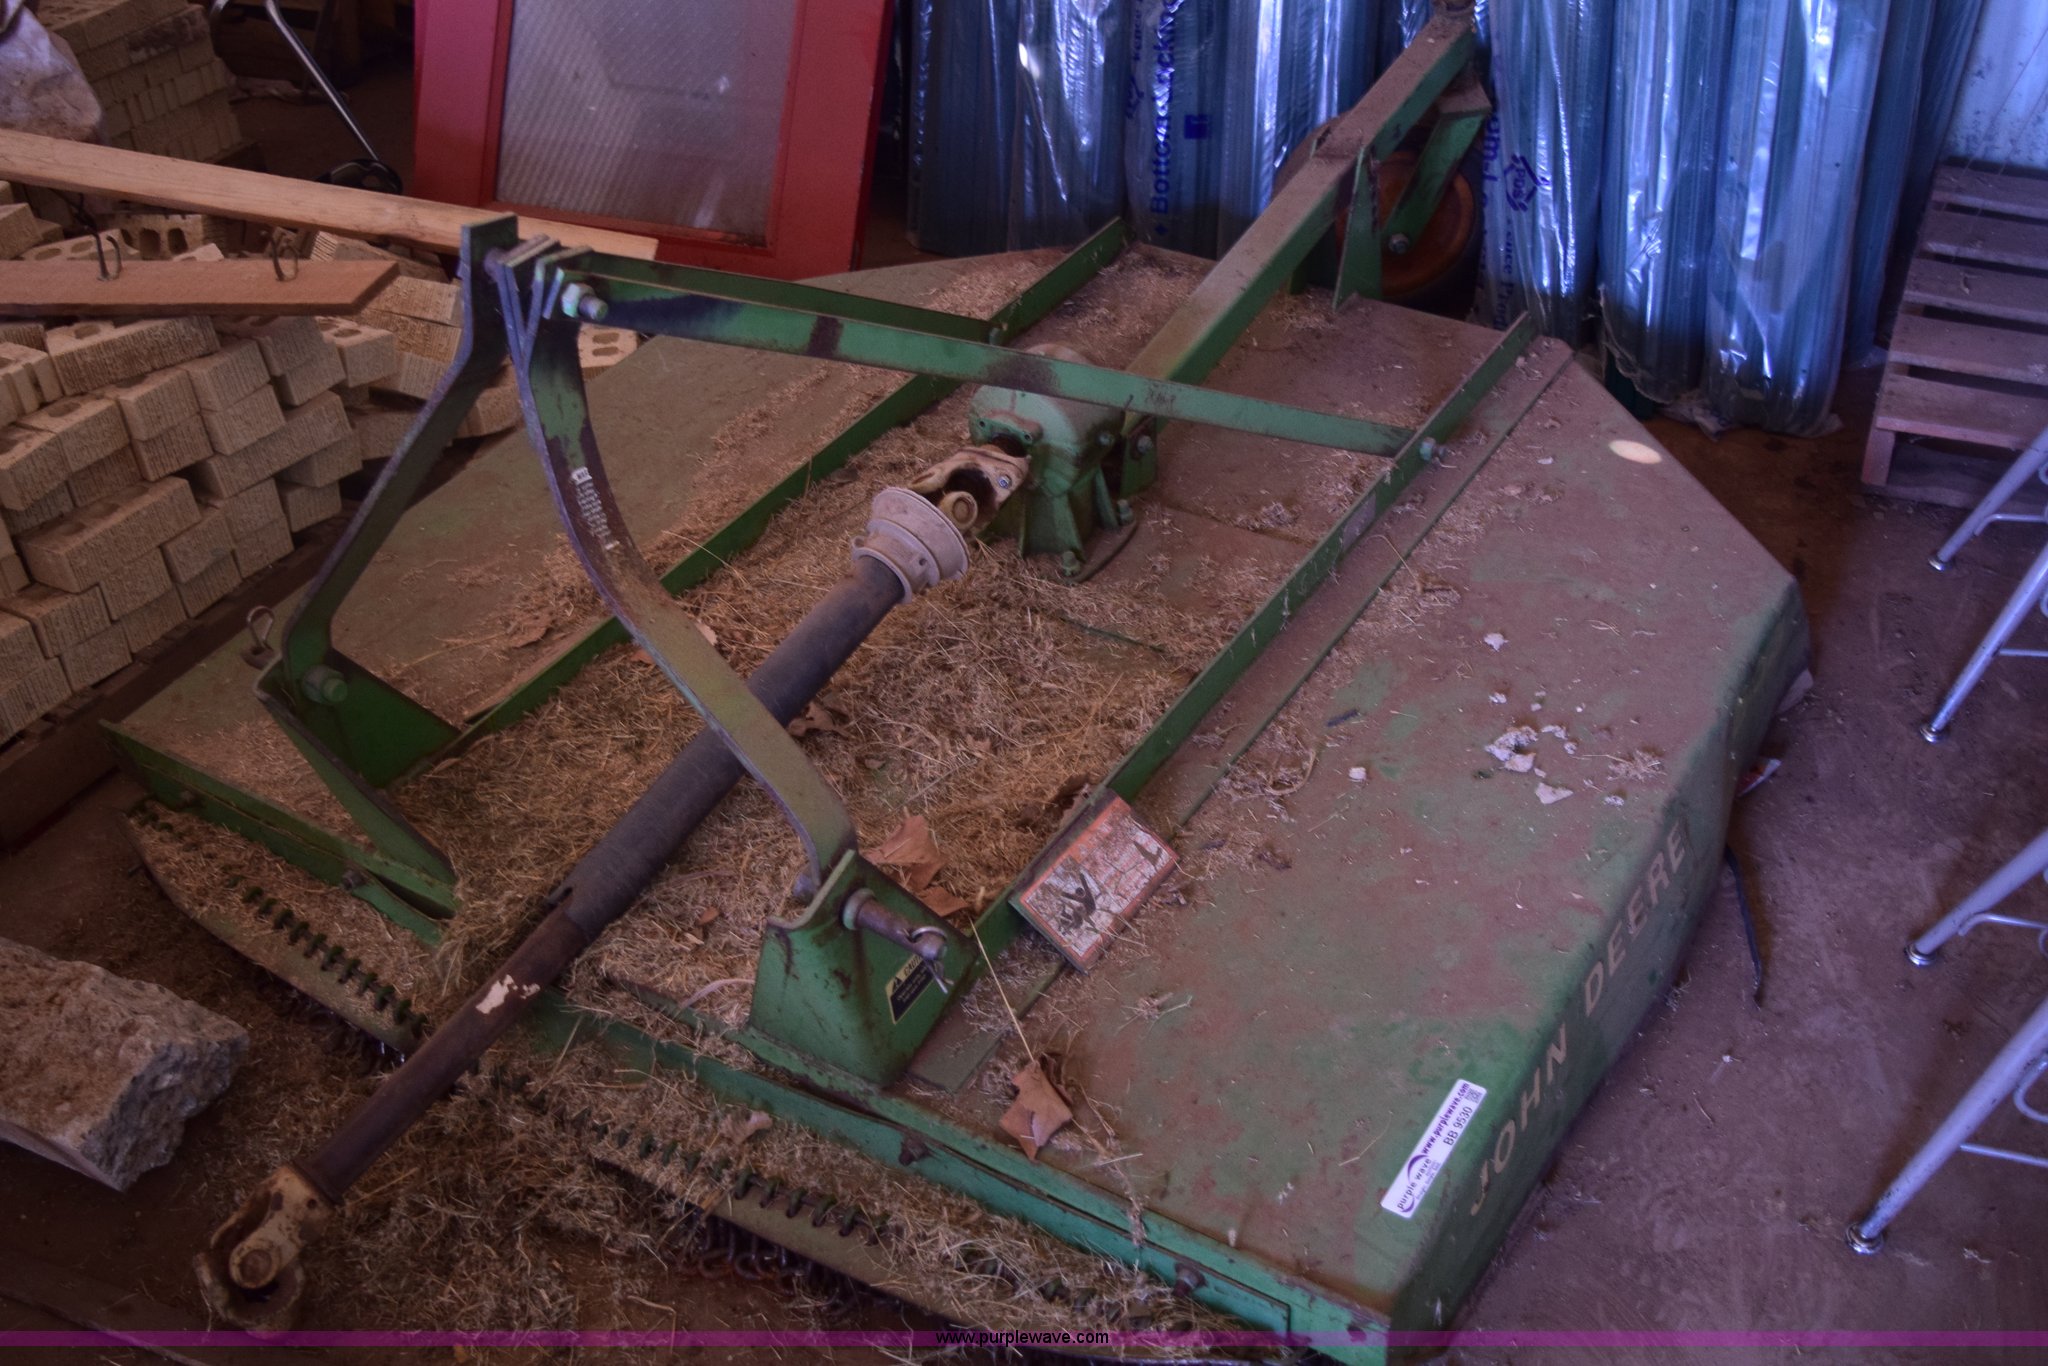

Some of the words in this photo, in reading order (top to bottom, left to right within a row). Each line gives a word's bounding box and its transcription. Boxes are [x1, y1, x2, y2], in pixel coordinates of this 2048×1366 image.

[1512, 167, 1526, 199] PDS
[1470, 1023, 1568, 1216] JOHN
[1585, 821, 1685, 1017] DEERE
[1421, 1083, 1469, 1154] www.purplewave.com
[1443, 1130, 1458, 1146] BB
[1453, 1106, 1472, 1129] 9530
[1397, 1182, 1417, 1210] purple
[1415, 1158, 1431, 1180] wave
